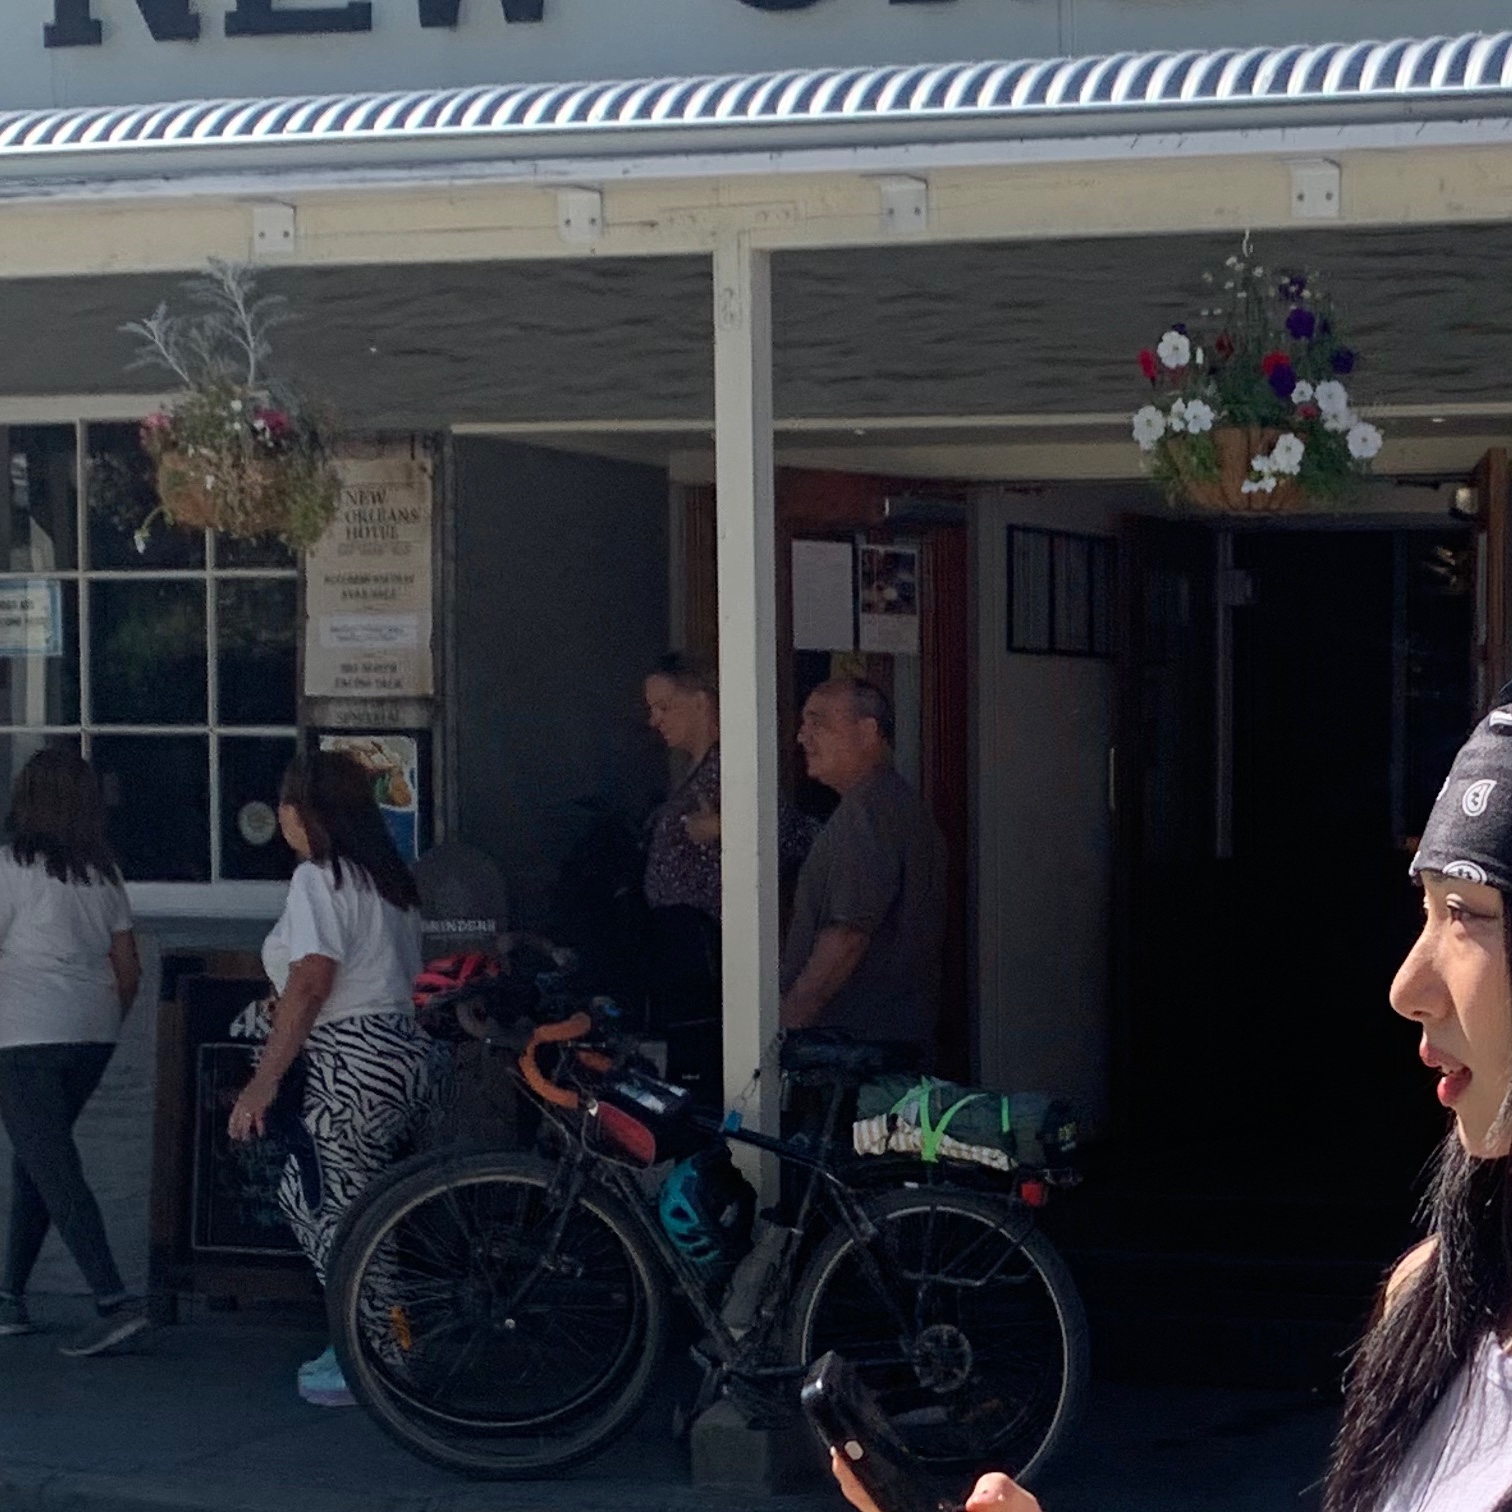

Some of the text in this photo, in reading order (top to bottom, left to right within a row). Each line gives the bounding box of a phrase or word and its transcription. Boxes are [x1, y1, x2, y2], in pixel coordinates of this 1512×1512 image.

[344, 488, 386, 505] NEW
[344, 507, 420, 524] ORLEANS
[345, 525, 398, 540] HOTEL
